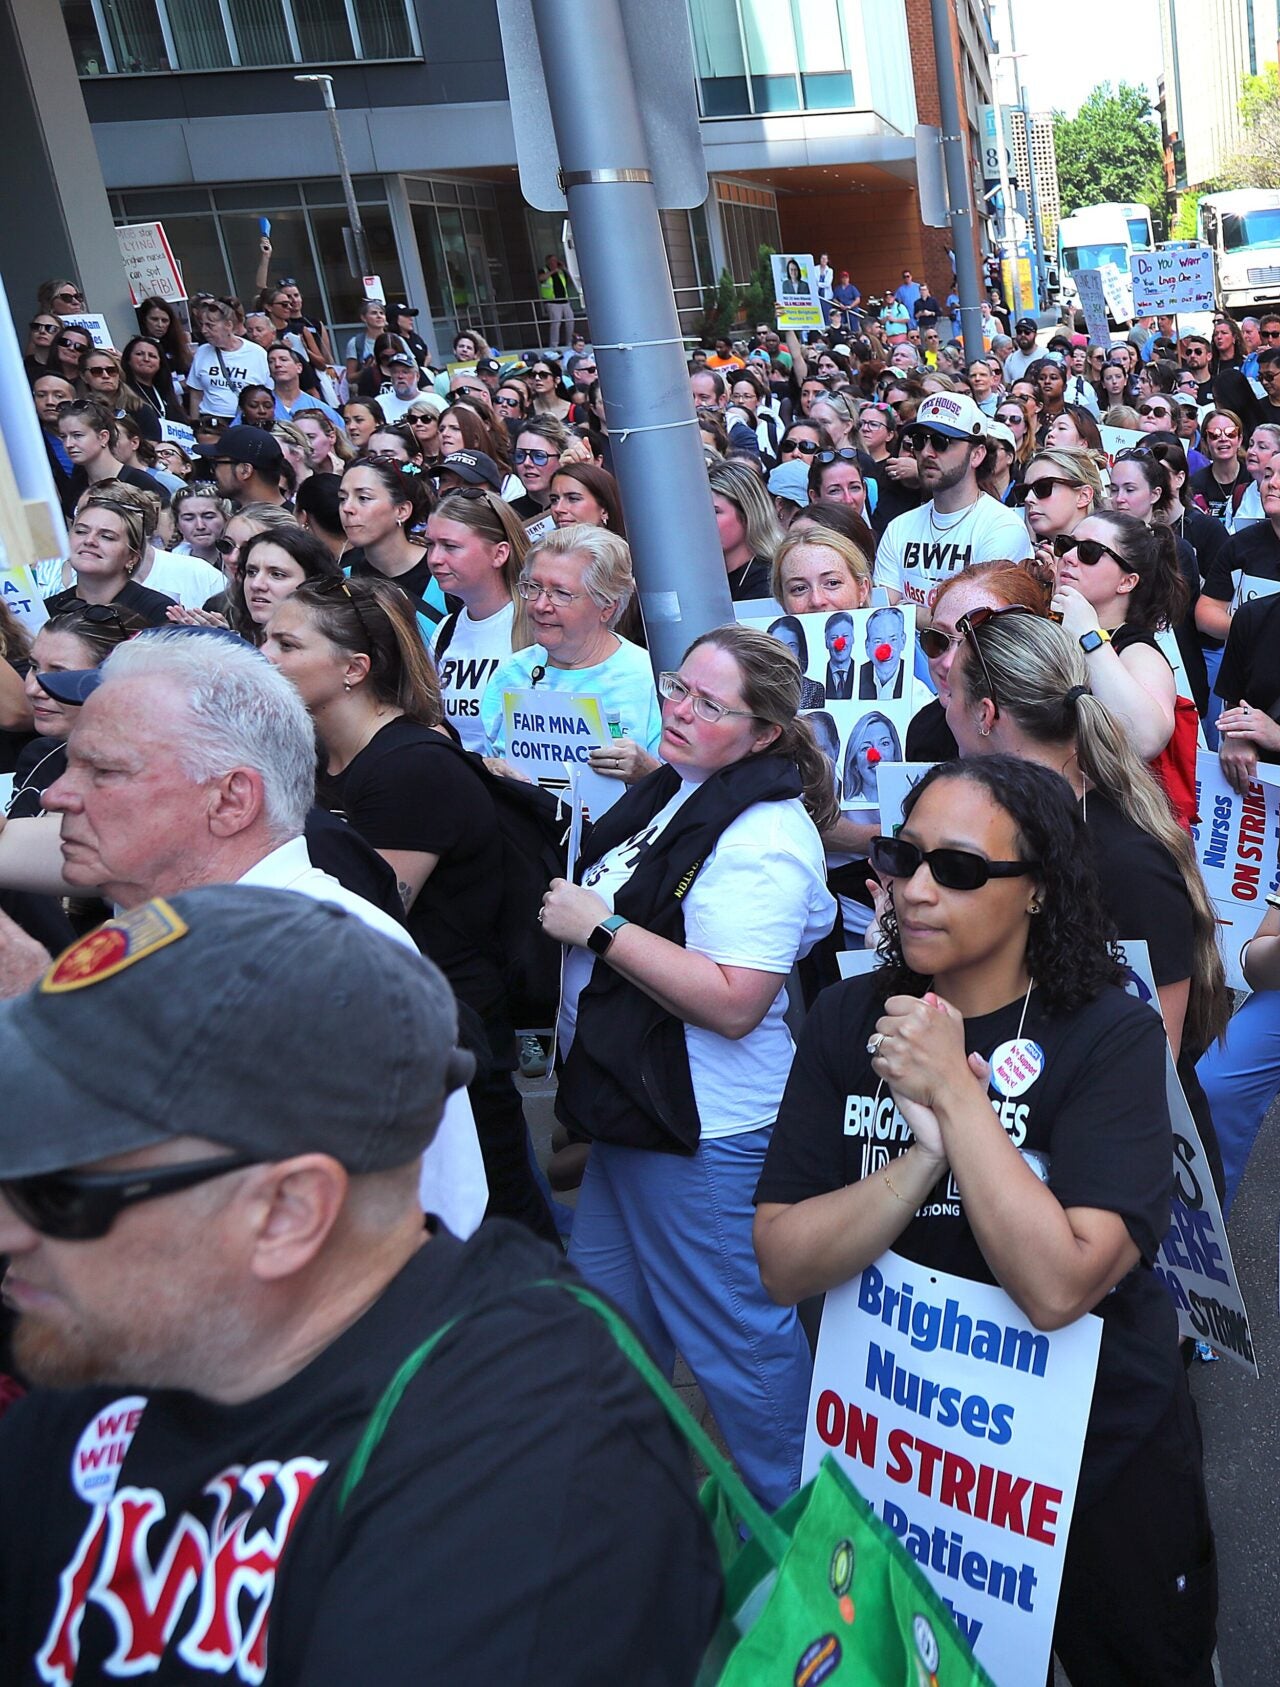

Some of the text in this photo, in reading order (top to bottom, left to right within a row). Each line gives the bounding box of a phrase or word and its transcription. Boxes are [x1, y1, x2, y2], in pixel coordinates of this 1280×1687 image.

[1138, 257, 1201, 275] Do YOU WANT
[935, 397, 962, 416] HOUSE
[904, 543, 972, 571] BWH
[904, 581, 924, 604] Mass
[513, 712, 590, 736] FAIR MNA
[1203, 795, 1232, 869] Nurses
[1232, 863, 1261, 901] ON
[1017, 1054, 1037, 1076] Support
[858, 1263, 1050, 1378] Brigham
[865, 1341, 1015, 1445] Nurses
[97, 1408, 143, 1439] WE
[816, 1389, 1063, 1547] ON STRIKE
[882, 1500, 1037, 1613] Patient
